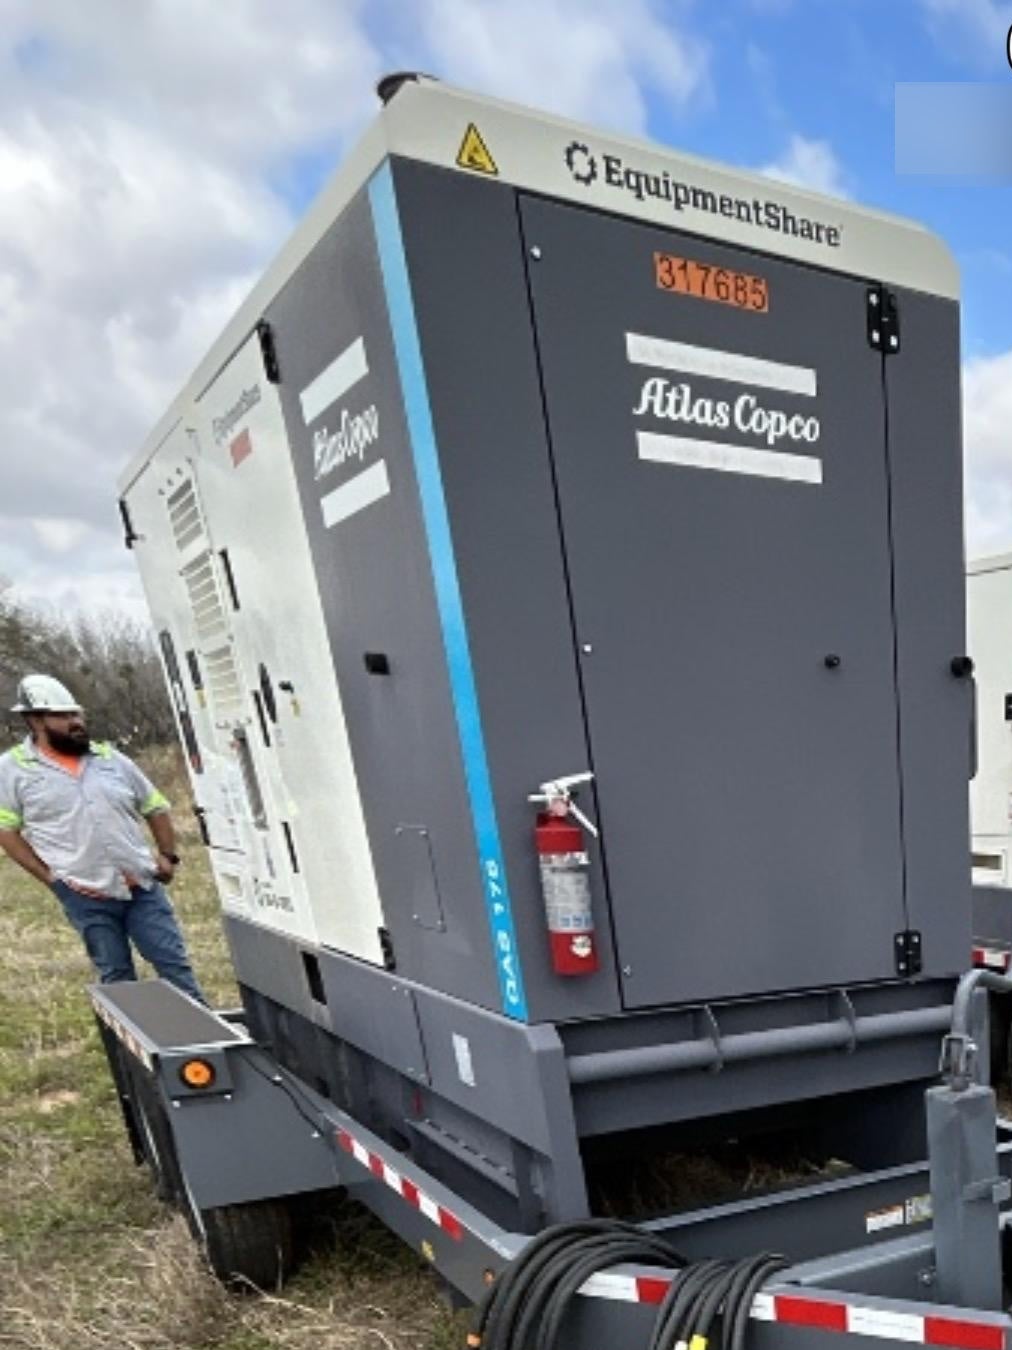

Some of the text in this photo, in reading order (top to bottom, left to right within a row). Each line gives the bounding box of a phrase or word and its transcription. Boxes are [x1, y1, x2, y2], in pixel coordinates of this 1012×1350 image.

[602, 153, 842, 248] EquipmentShare
[659, 255, 766, 310] 317685
[633, 376, 820, 445] Atlas Copco
